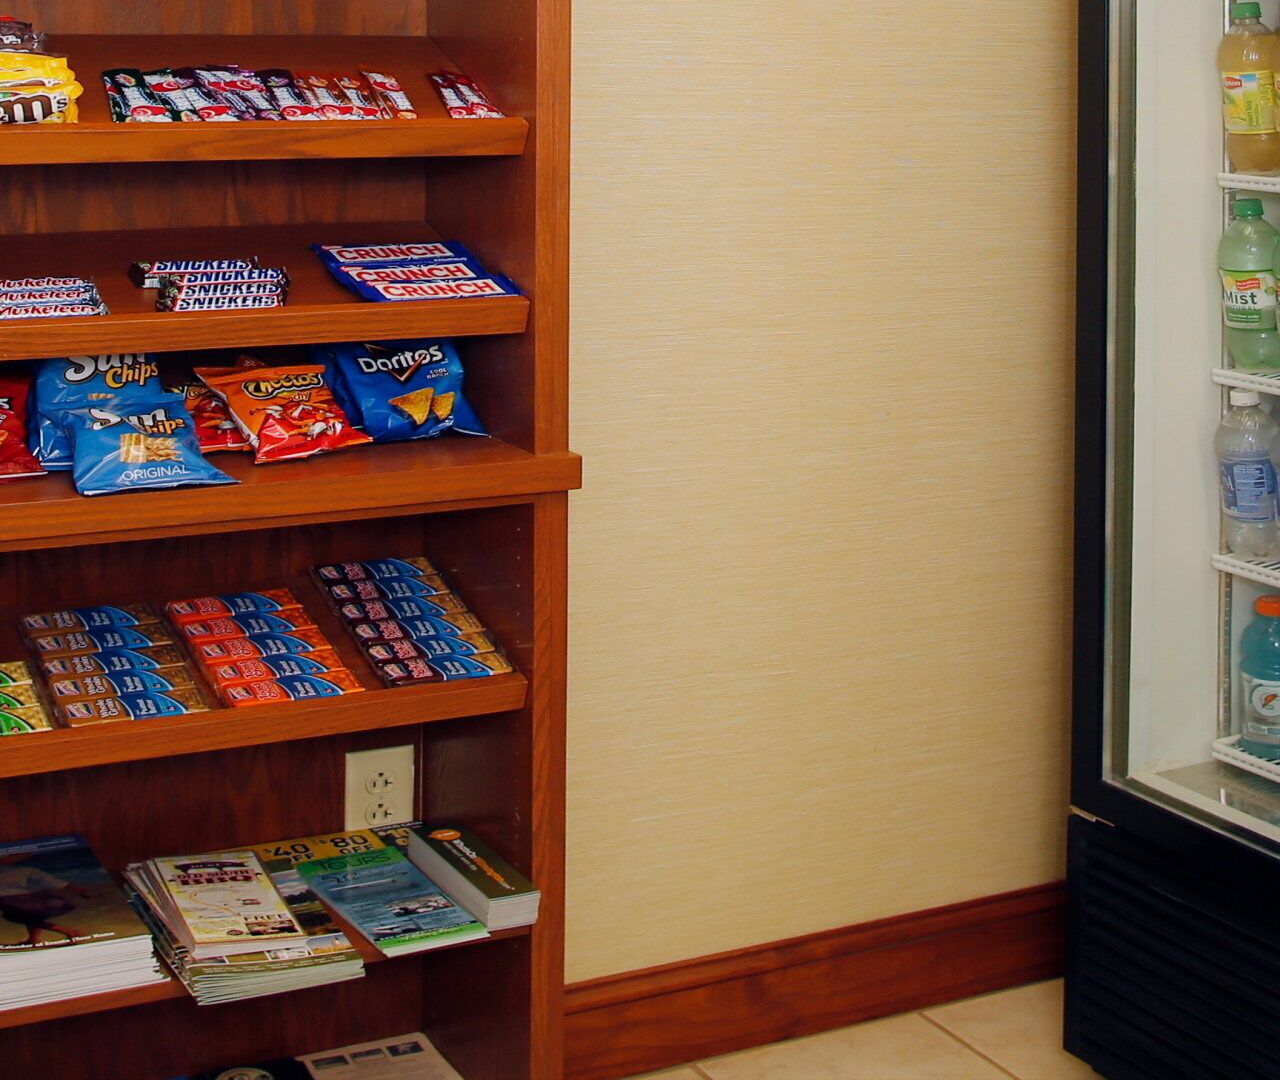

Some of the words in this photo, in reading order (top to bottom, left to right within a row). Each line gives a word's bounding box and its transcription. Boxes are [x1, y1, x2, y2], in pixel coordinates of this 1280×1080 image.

[336, 244, 450, 261] CRUNCH
[186, 269, 281, 283] SNICKERS
[355, 265, 470, 282] CRUNCH
[382, 281, 497, 297] CRUNCH
[358, 345, 445, 373] Doritos
[105, 362, 159, 388] Chips
[121, 464, 191, 482] ORIGINAL
[319, 853, 392, 871] TOURS
[243, 913, 286, 922] FREE
